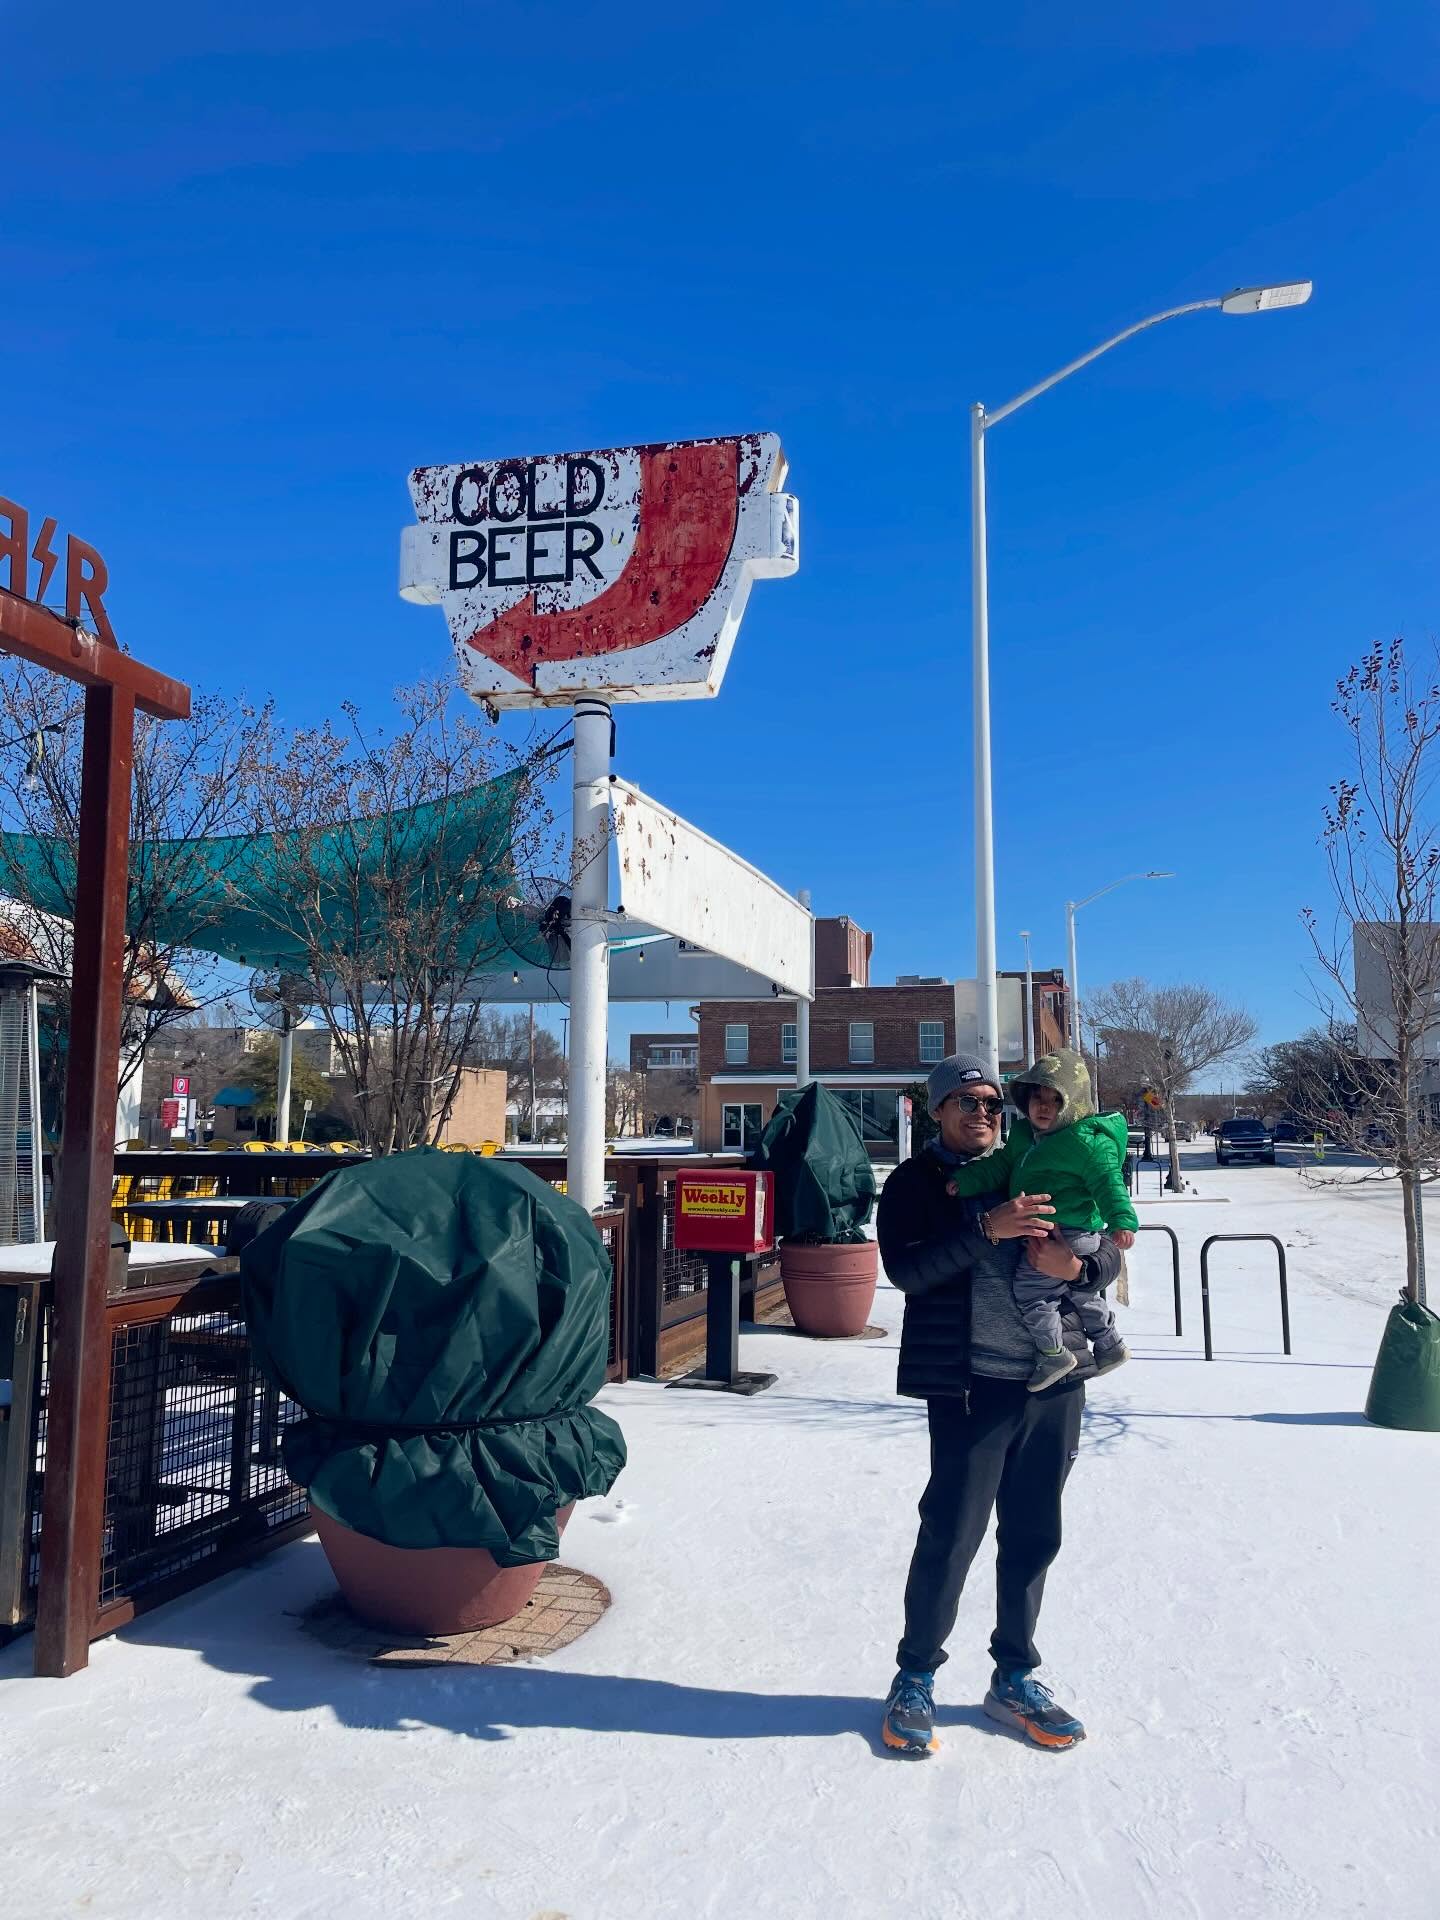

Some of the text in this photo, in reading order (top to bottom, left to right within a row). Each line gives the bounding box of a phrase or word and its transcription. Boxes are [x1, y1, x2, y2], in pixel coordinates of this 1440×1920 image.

[451, 457, 605, 527] COLD
[450, 521, 605, 591] BEER
[683, 1189, 745, 1207] Weekly
